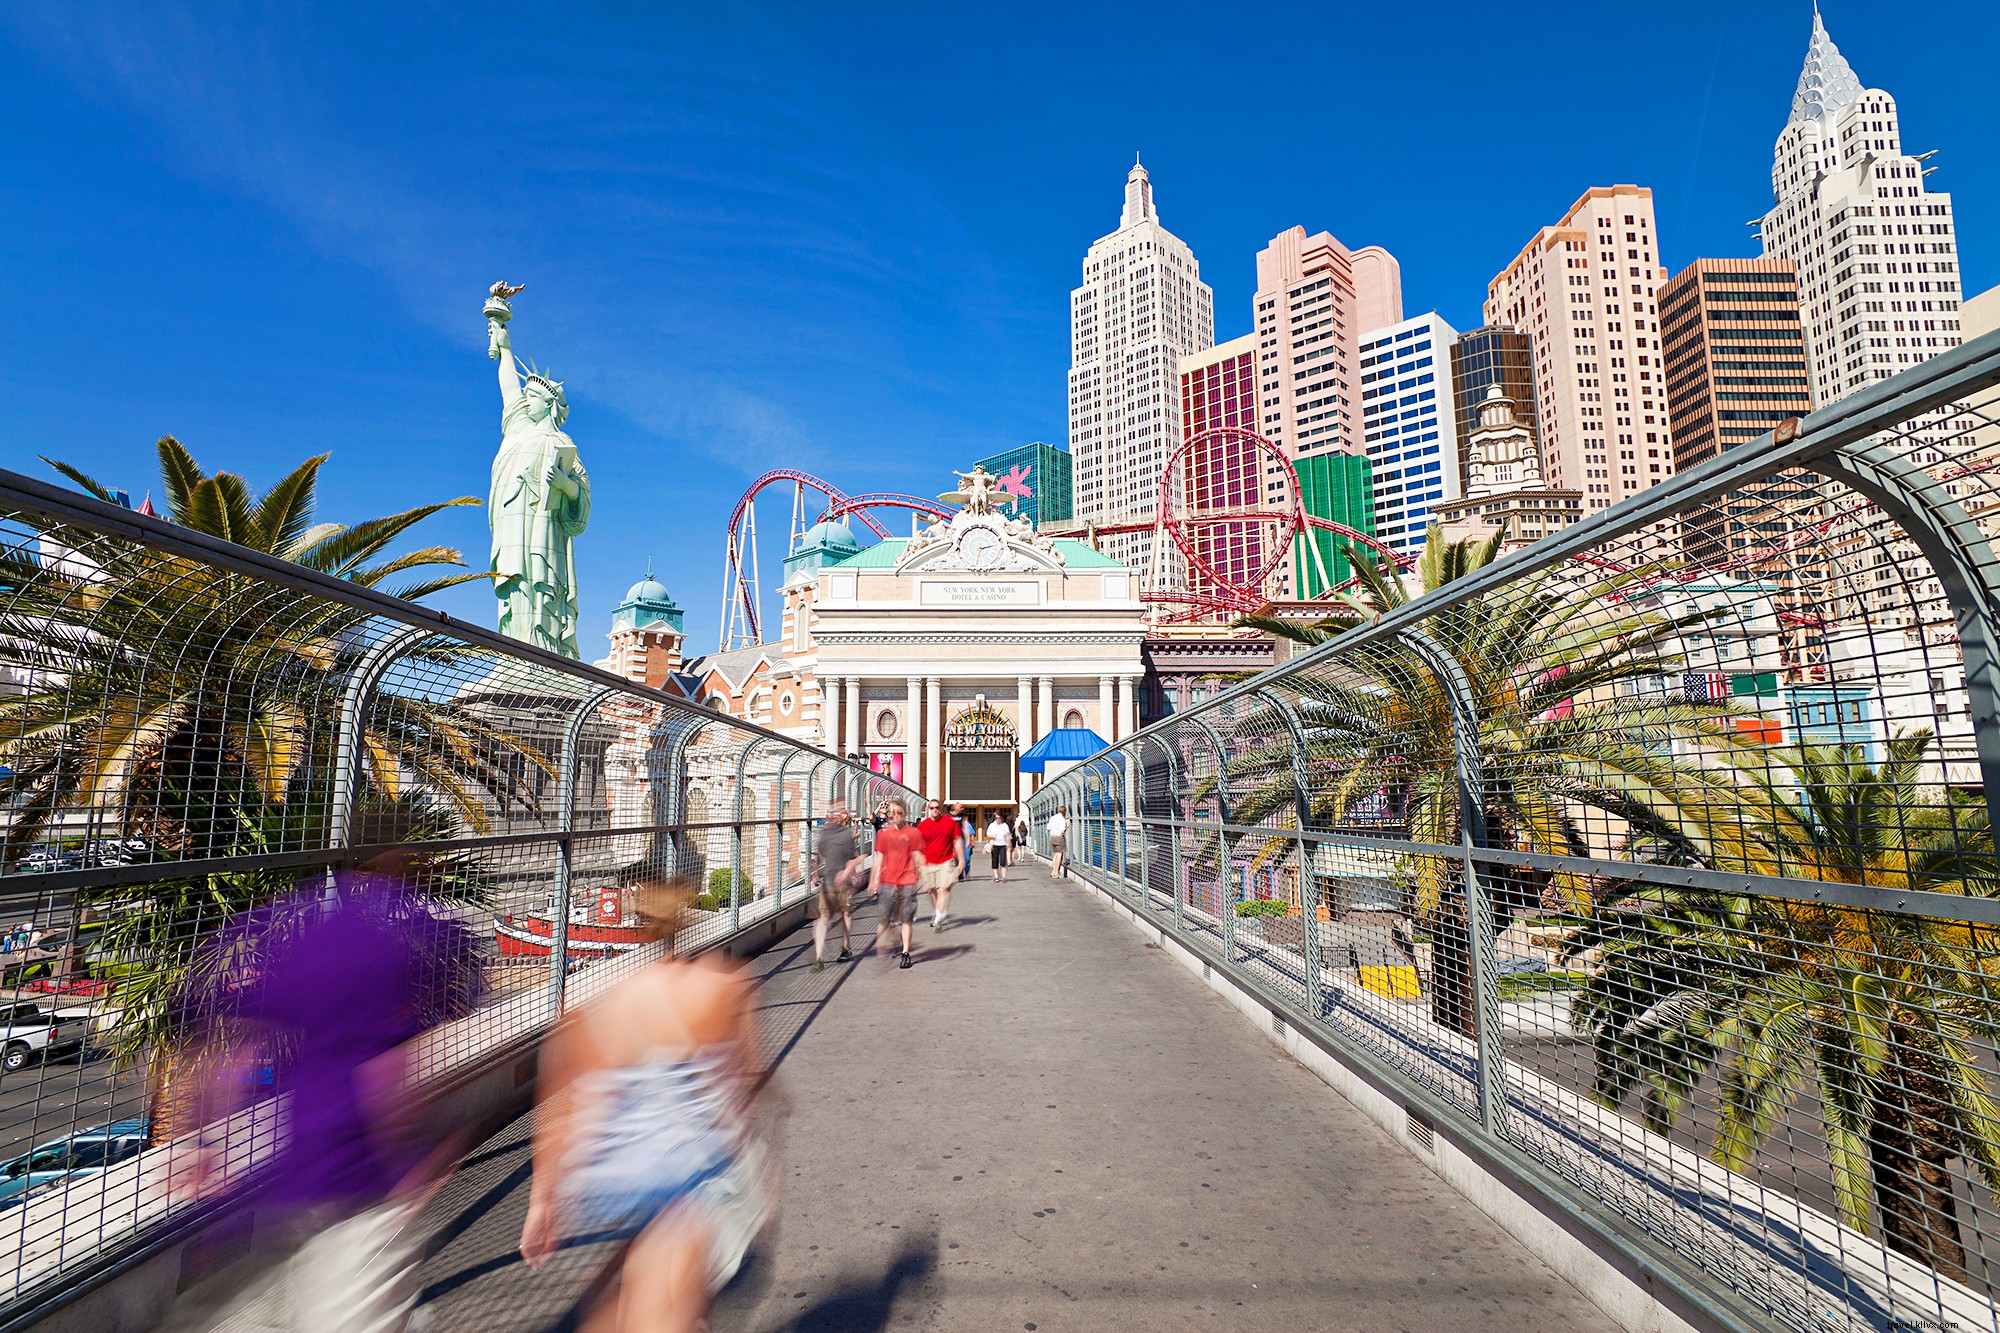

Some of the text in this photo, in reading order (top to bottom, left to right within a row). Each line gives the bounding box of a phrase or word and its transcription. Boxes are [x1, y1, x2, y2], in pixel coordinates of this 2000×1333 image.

[949, 724, 1012, 735] NEW YORK
[948, 736, 1012, 747] NEW YORK
